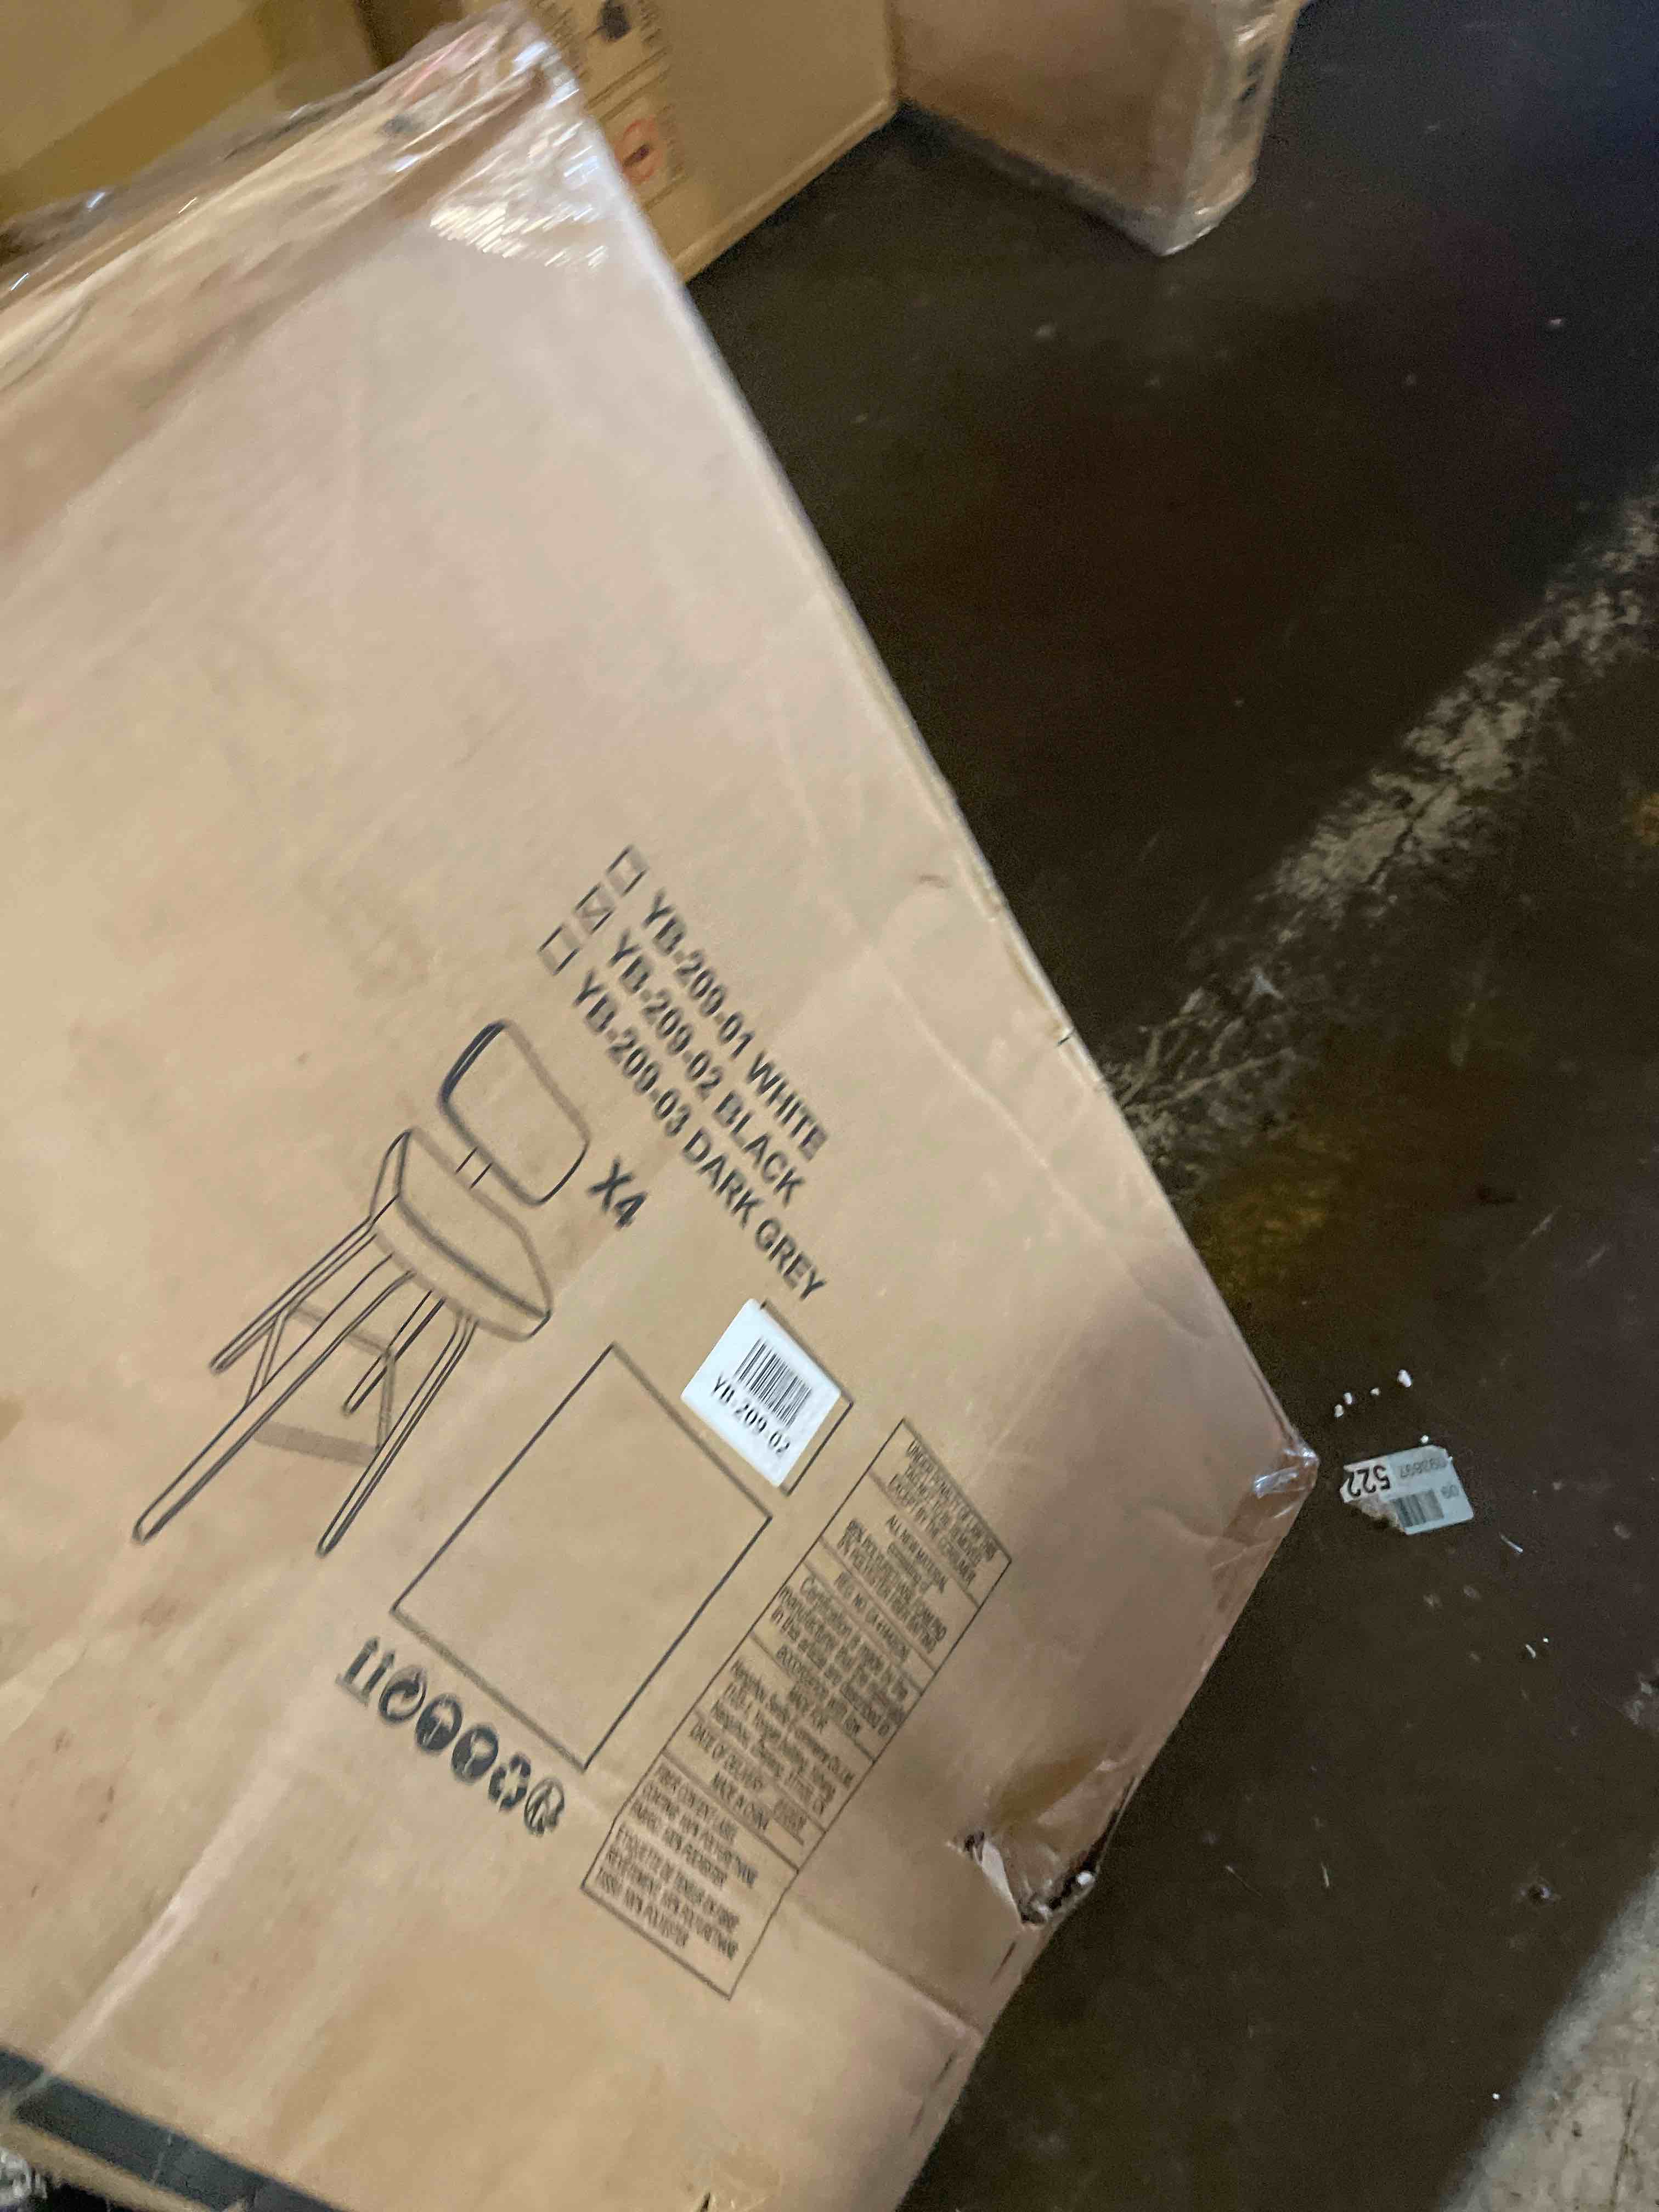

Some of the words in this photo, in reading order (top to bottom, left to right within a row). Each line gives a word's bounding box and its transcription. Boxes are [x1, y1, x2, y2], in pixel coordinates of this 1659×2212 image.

[712, 1090, 806, 1207] BLACK
[745, 1049, 830, 1163] WHITE
[680, 1126, 765, 1229] DARK
[754, 1218, 827, 1301] GREY
[1347, 1465, 1391, 1497] 522
